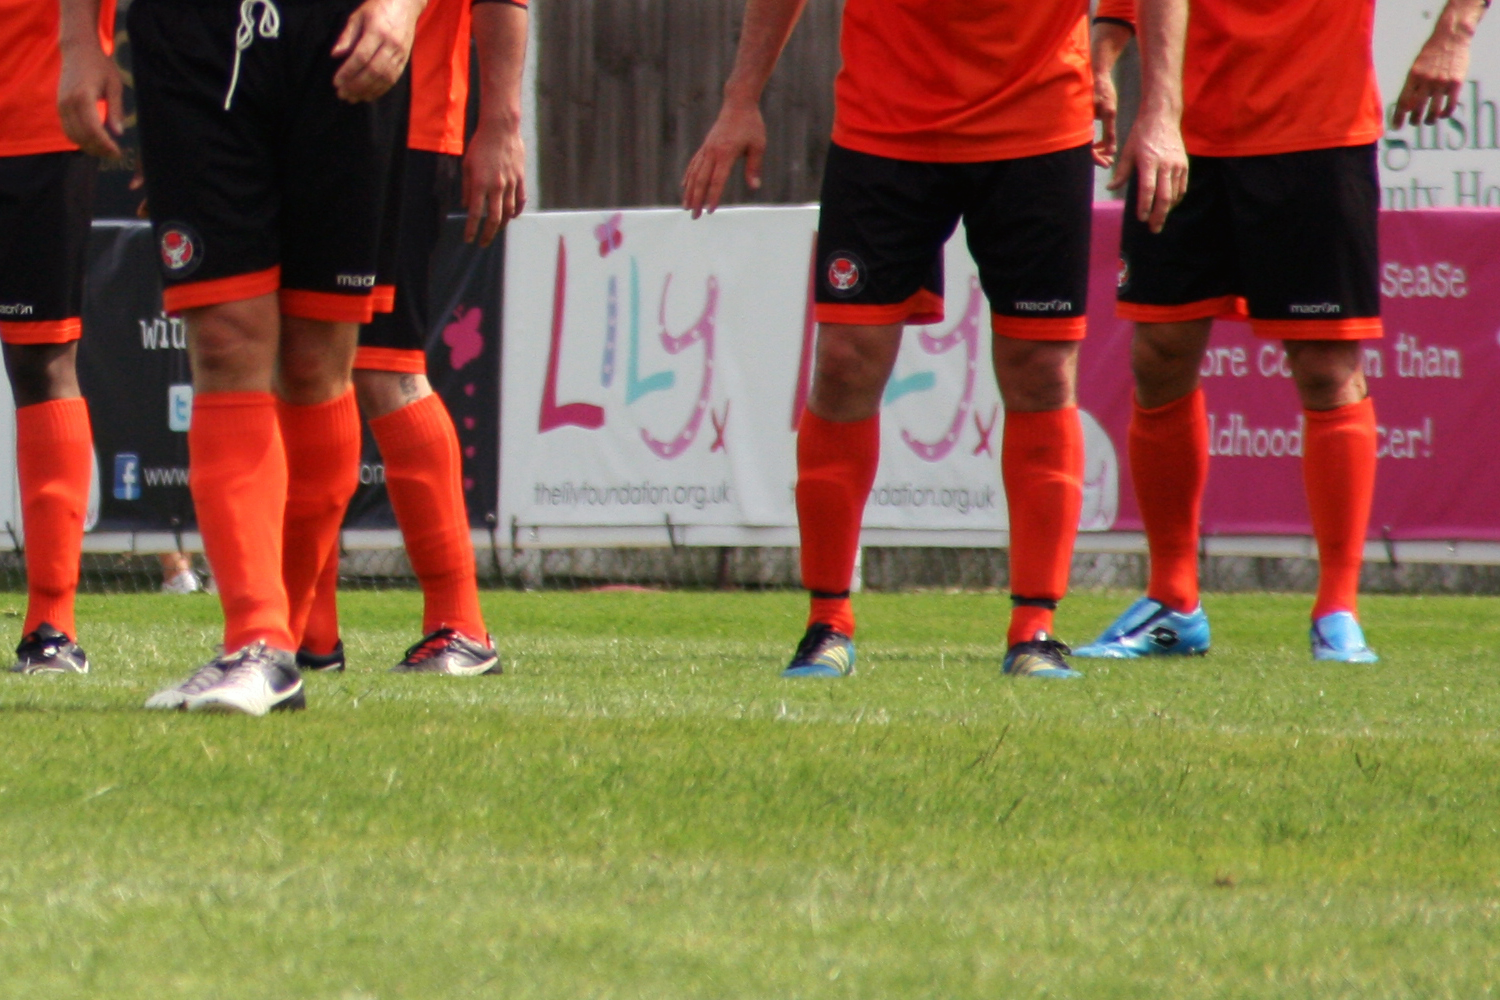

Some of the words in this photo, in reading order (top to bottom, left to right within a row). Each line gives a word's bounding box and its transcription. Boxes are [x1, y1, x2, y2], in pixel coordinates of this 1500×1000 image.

[1015, 299, 1072, 311] macron
[1290, 302, 1340, 314] macron
[1394, 333, 1462, 378] than
[534, 481, 731, 510] thelilyfoundation.org.uk
